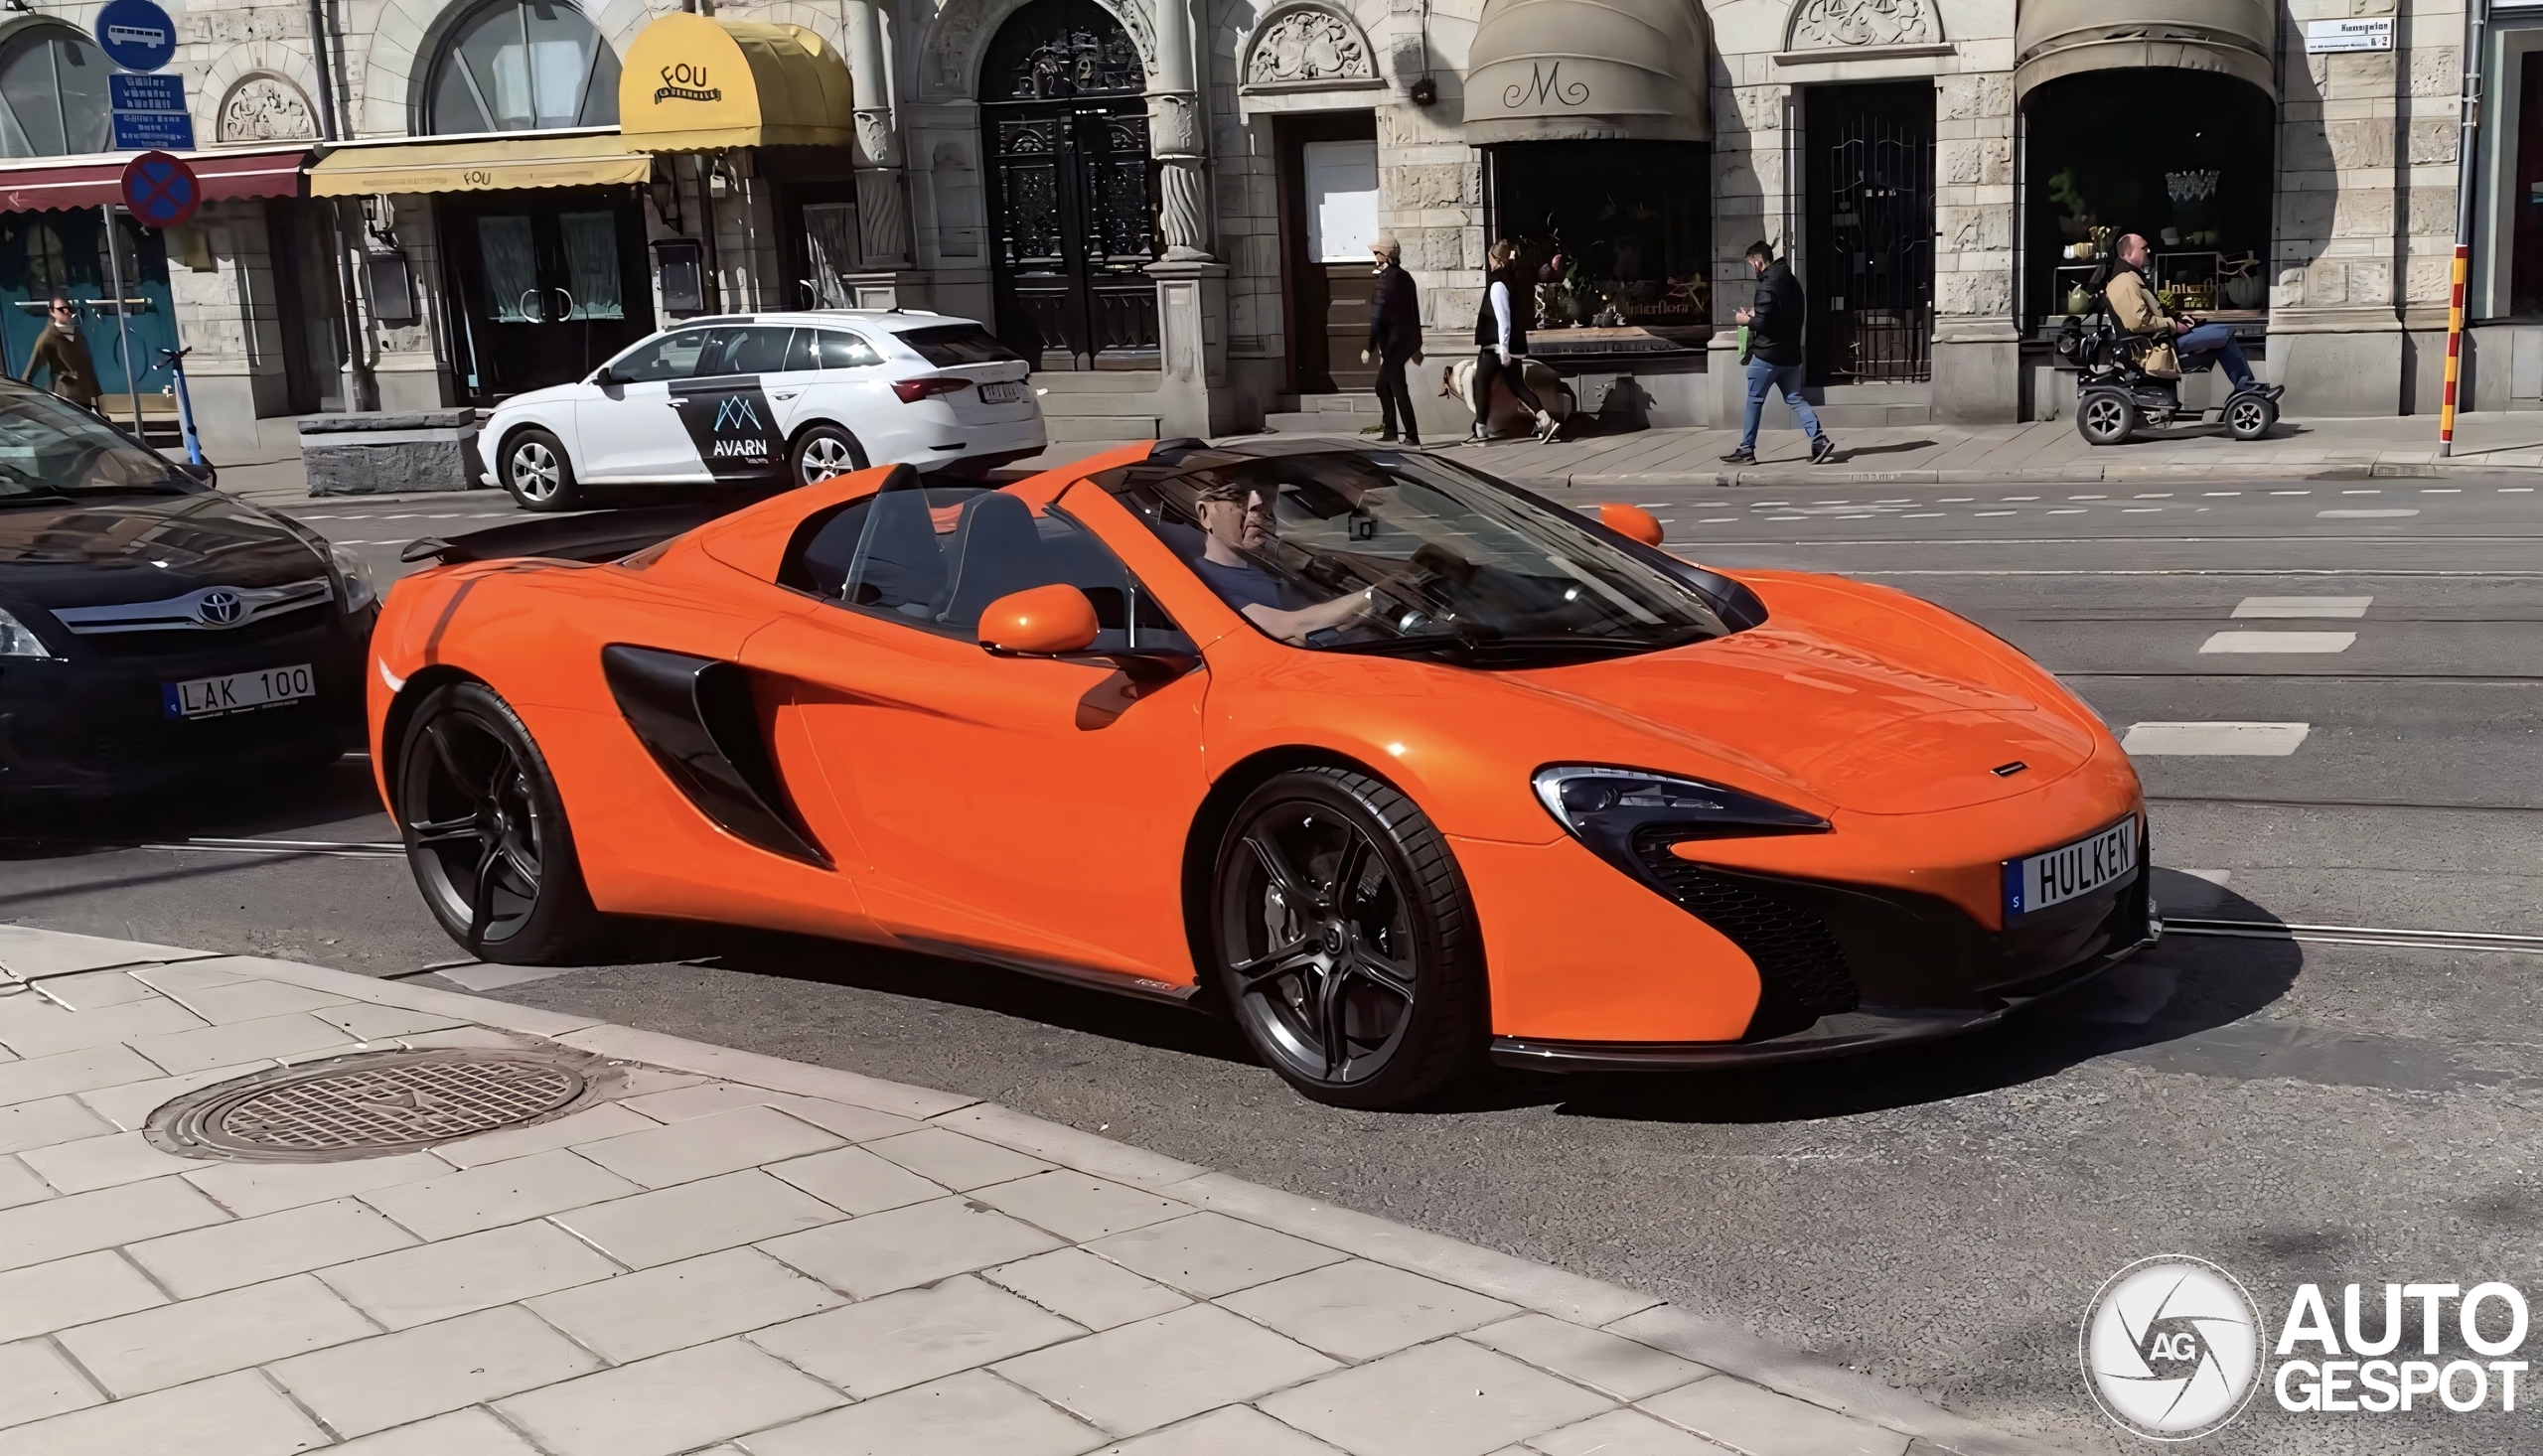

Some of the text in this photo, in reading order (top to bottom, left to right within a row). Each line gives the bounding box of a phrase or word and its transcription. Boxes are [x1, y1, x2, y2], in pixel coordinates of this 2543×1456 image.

[661, 63, 706, 88] FOU
[1503, 61, 1589, 108] M
[464, 171, 491, 186] FOU
[713, 439, 768, 456] AVARN
[183, 678, 237, 711] LAK
[260, 668, 309, 699] 100
[2039, 825, 2130, 904] HULKEN
[2013, 896, 2019, 908] S
